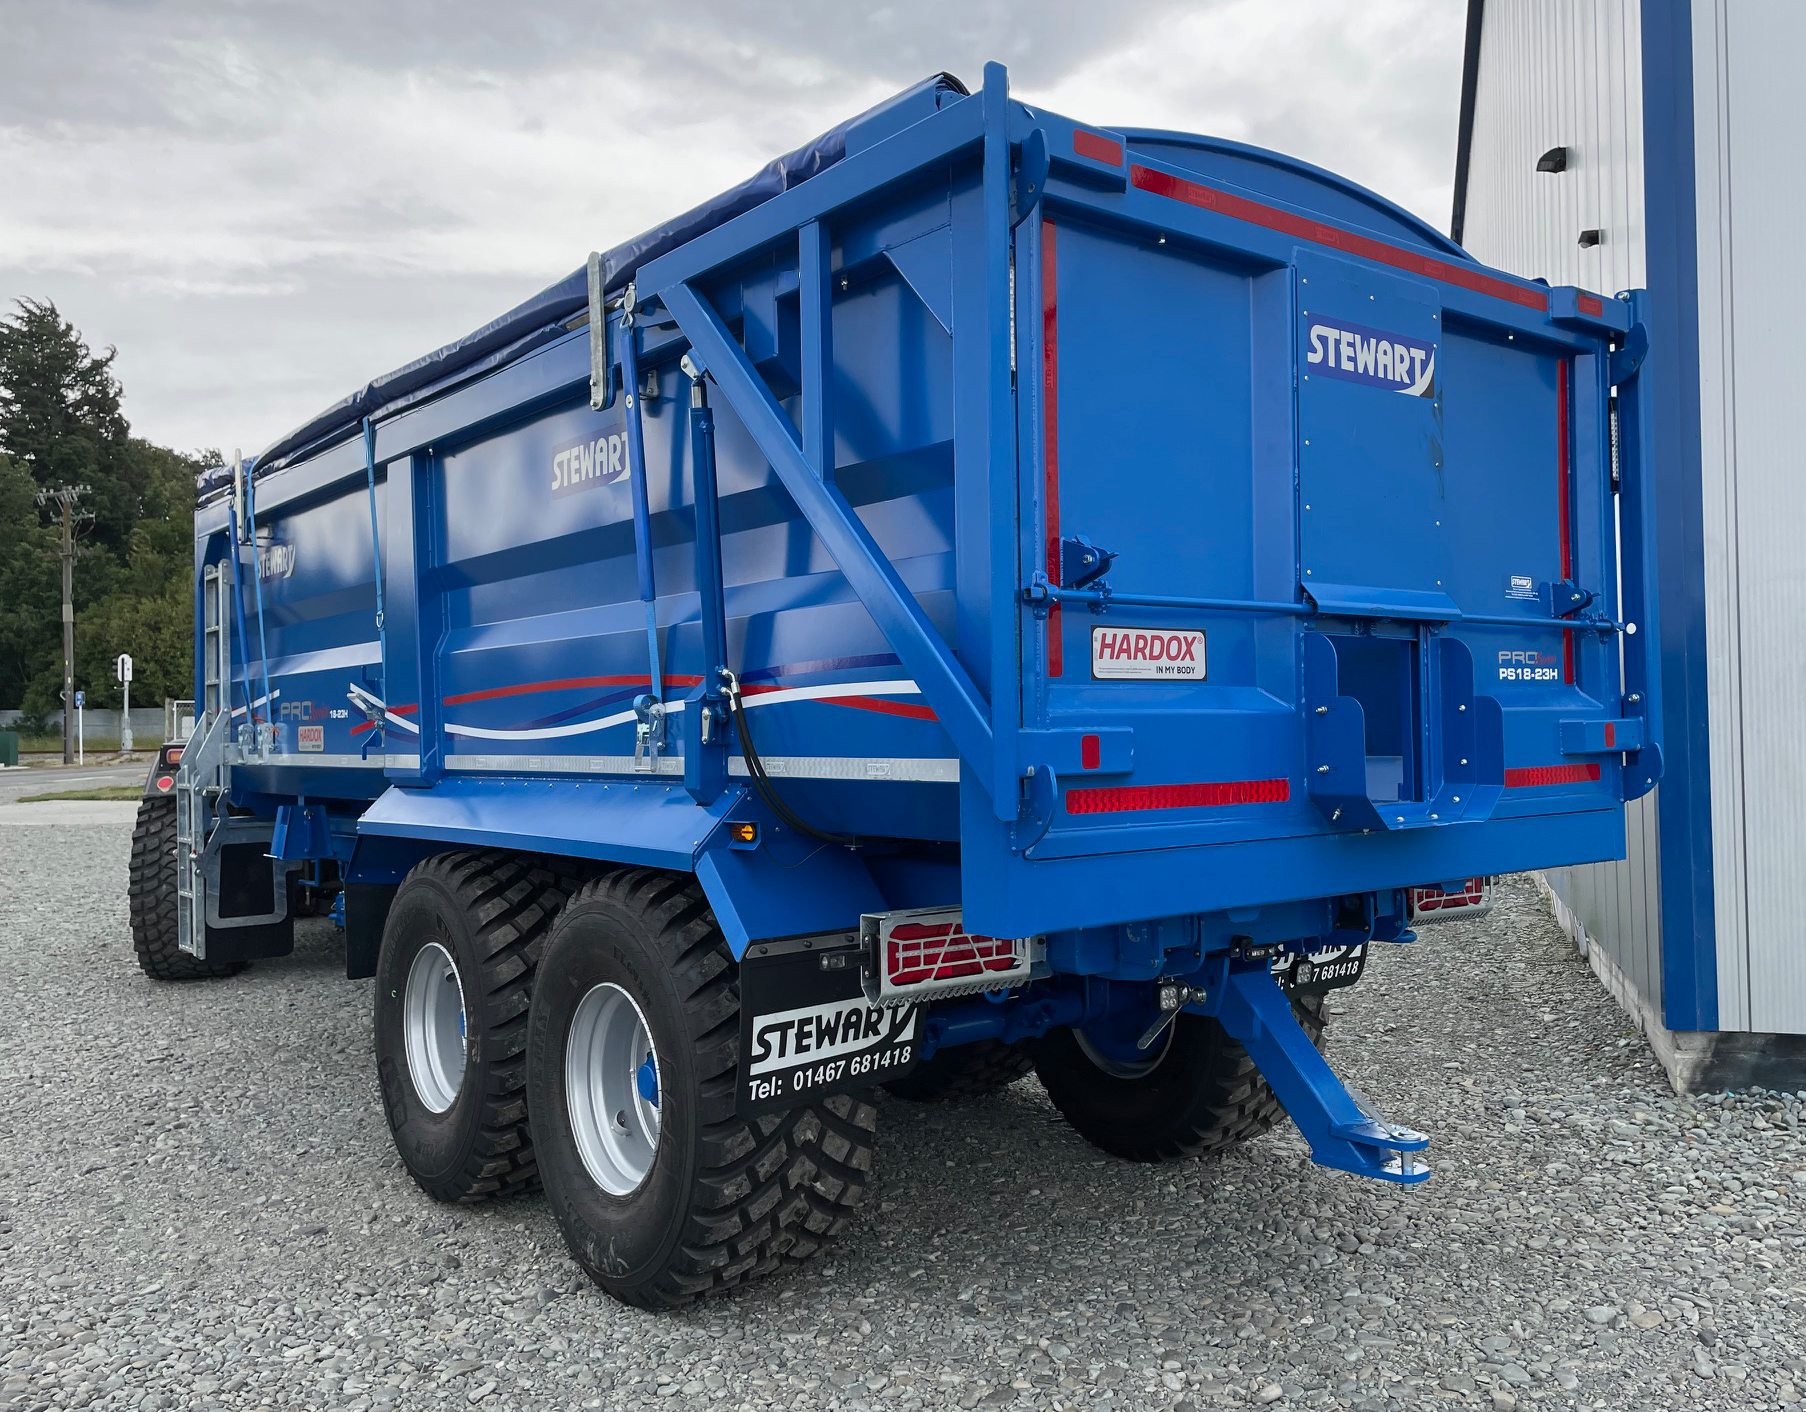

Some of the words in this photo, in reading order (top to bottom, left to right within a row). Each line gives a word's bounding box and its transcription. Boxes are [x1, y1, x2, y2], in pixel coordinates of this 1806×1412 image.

[1307, 324, 1434, 397] STEWART
[1499, 651, 1539, 664] PRO
[1156, 666, 1164, 674] IN
[1165, 666, 1176, 674] MY
[1177, 666, 1196, 674] BODY
[1499, 668, 1558, 680] PS18-23H
[281, 701, 312, 721] PRO
[1321, 961, 1359, 980] 681418
[751, 1003, 922, 1065] STEWART
[749, 1076, 782, 1101] Tel:
[793, 1059, 846, 1091] 01467
[850, 1046, 912, 1076] 681418
